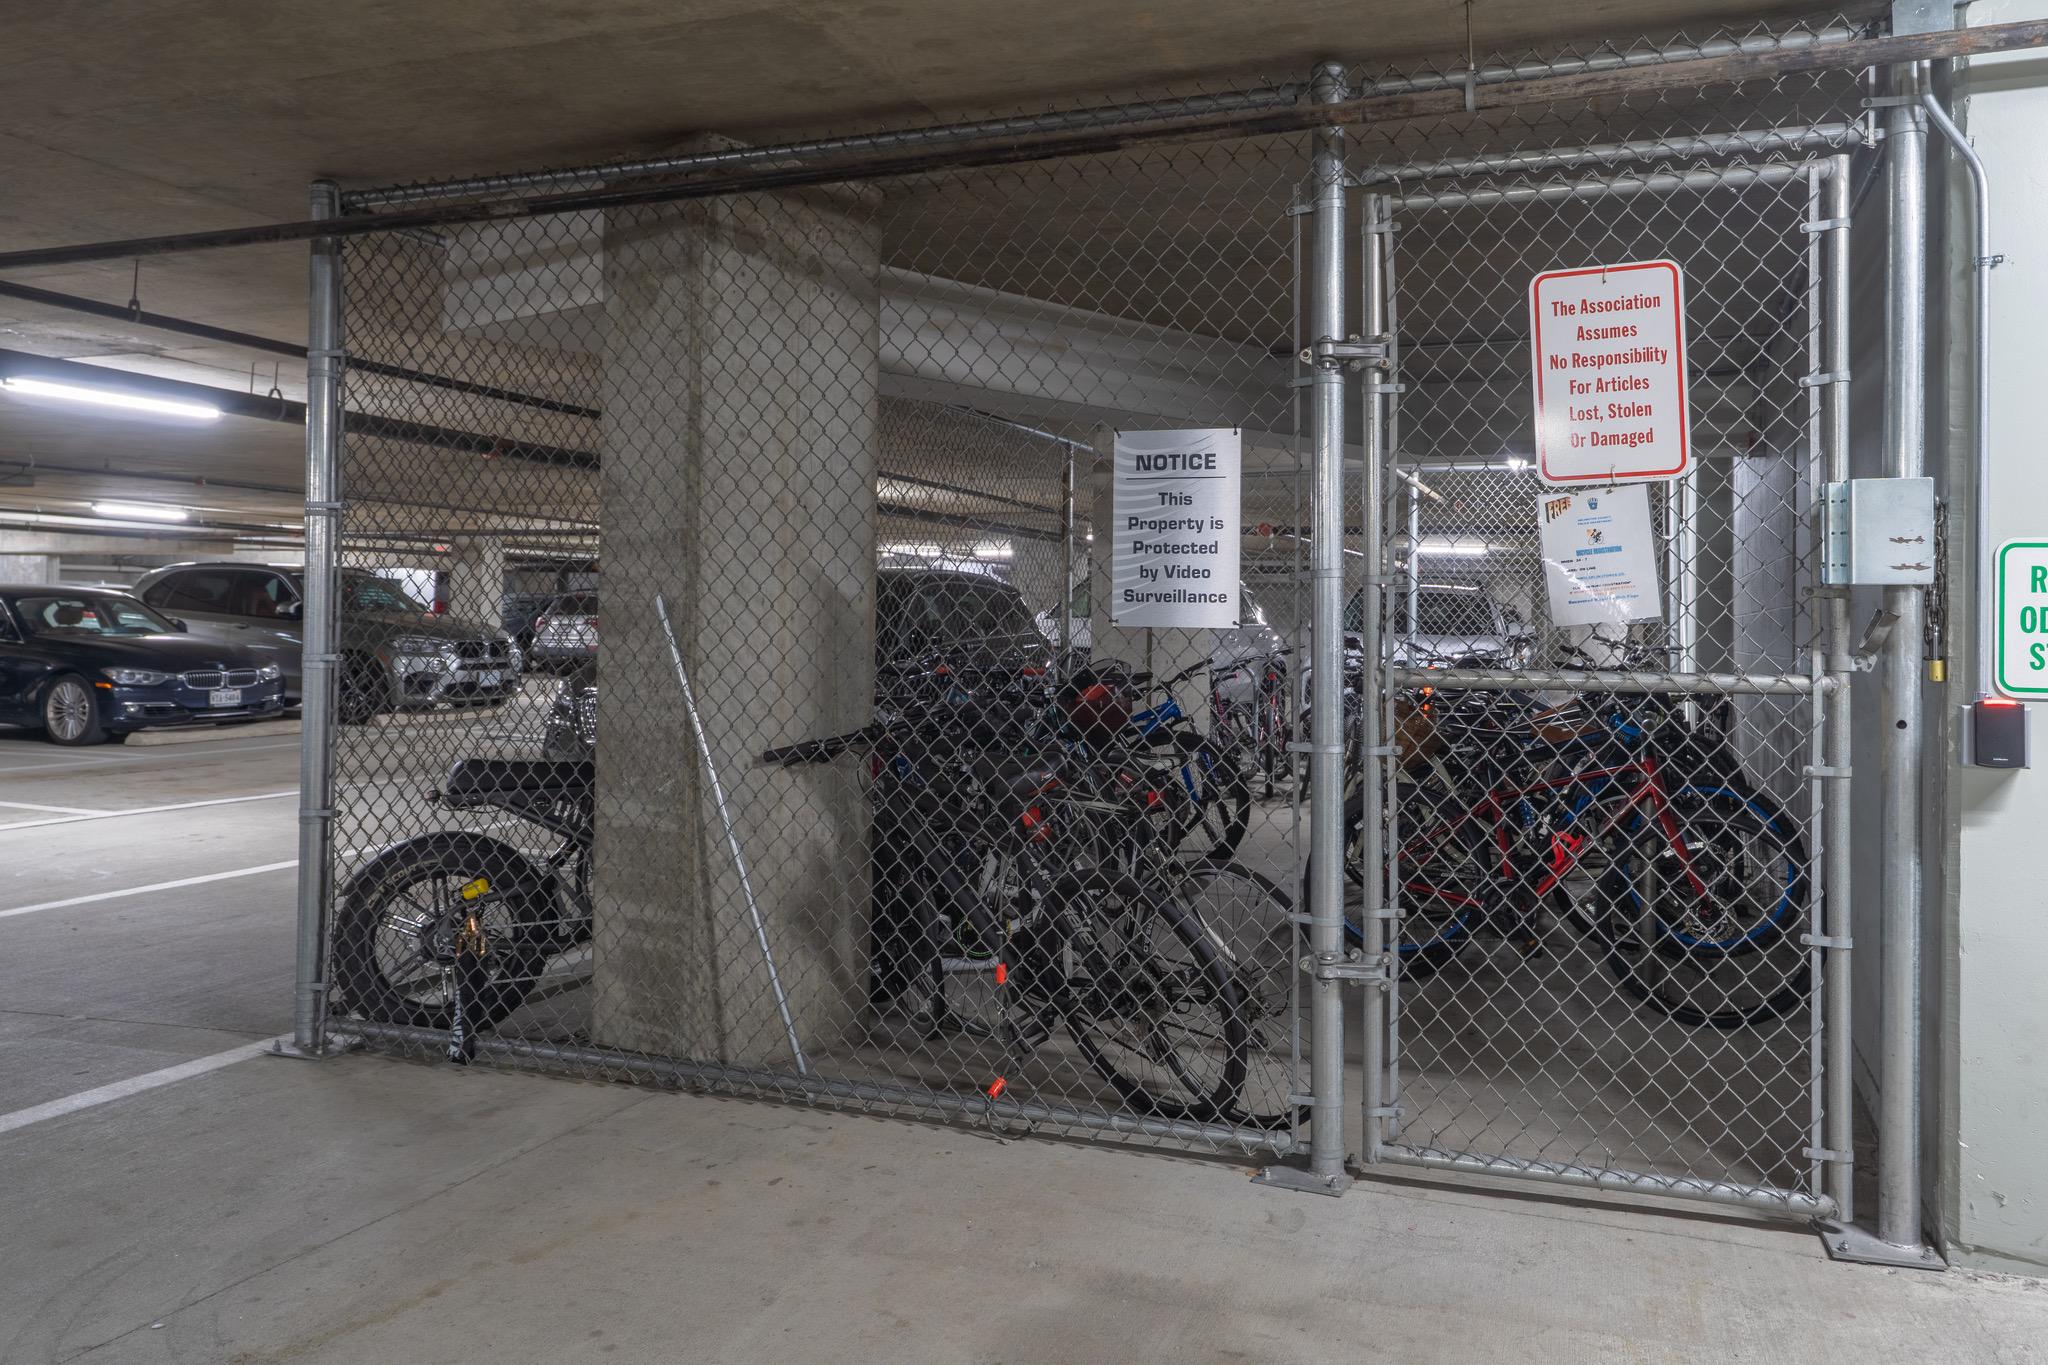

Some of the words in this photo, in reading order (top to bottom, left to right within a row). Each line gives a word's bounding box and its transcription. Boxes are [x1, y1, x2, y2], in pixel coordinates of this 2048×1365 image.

[1551, 301, 1576, 317] The
[1580, 294, 1660, 315] Association
[1576, 325, 1638, 341] Assumes
[1550, 354, 1568, 369] No
[1572, 346, 1667, 368] Responsibility
[1570, 379, 1591, 395] For
[1596, 375, 1649, 393] Articles
[1569, 404, 1603, 422] Lost,
[1608, 401, 1652, 419] Stolen
[1570, 432, 1587, 448] Or
[1591, 428, 1653, 449] Damaged
[1135, 453, 1216, 471] NOTICE
[1158, 491, 1193, 506] This
[1545, 496, 1571, 523] FREE
[1128, 516, 1204, 533] Property
[1210, 516, 1224, 530] is
[1132, 541, 1218, 554] Protected
[1139, 565, 1159, 582] by
[1164, 565, 1211, 579] Video
[1123, 589, 1227, 603] Surveillance
[2029, 642, 2048, 671] S
